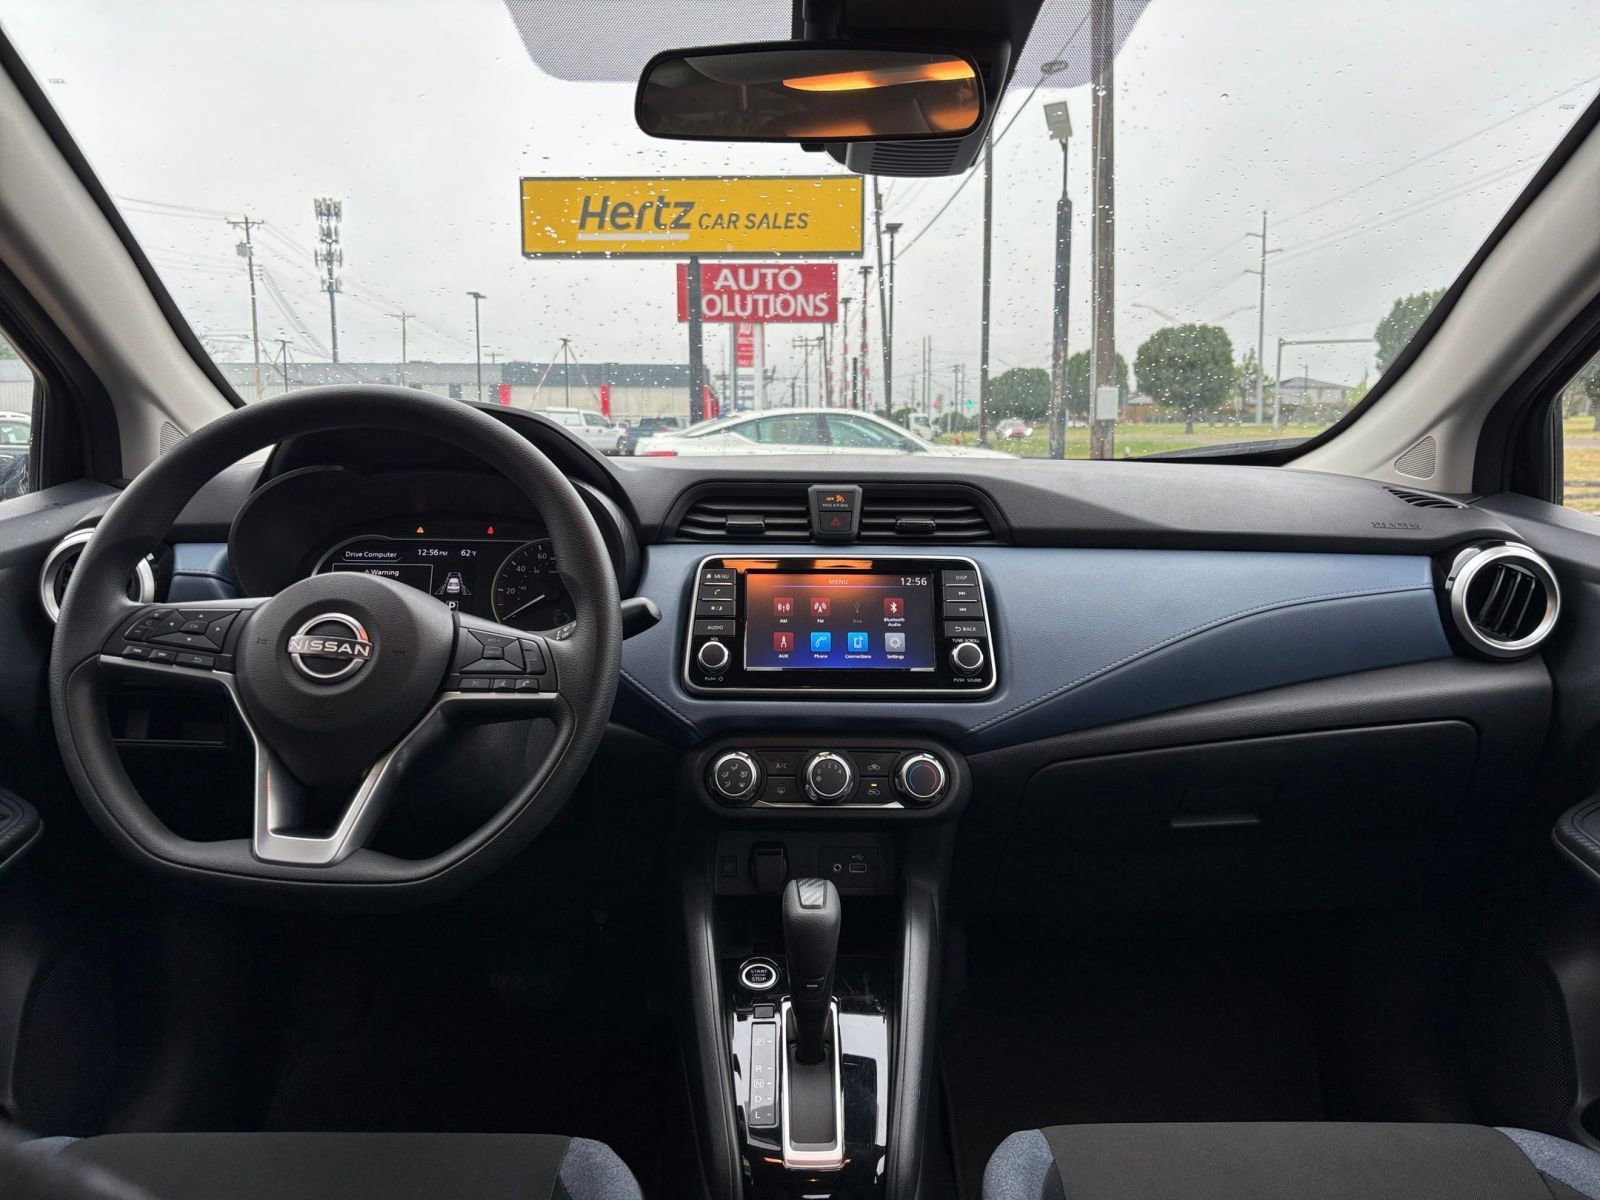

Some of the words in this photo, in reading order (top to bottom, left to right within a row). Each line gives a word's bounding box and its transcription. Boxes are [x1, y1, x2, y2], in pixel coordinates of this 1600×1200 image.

[578, 195, 696, 231] Hertz
[698, 213, 741, 230] CAR
[744, 213, 809, 230] SALES
[713, 268, 803, 291] AUTO
[702, 293, 829, 317] OLUTIONS
[363, 551, 398, 559] Computer
[537, 552, 548, 560] 60
[370, 569, 400, 577] Warning
[900, 577, 928, 586] 12:56
[506, 587, 516, 595] 20
[448, 601, 456, 611] P
[289, 640, 371, 657] NISSAN
[755, 1111, 761, 1119] L
